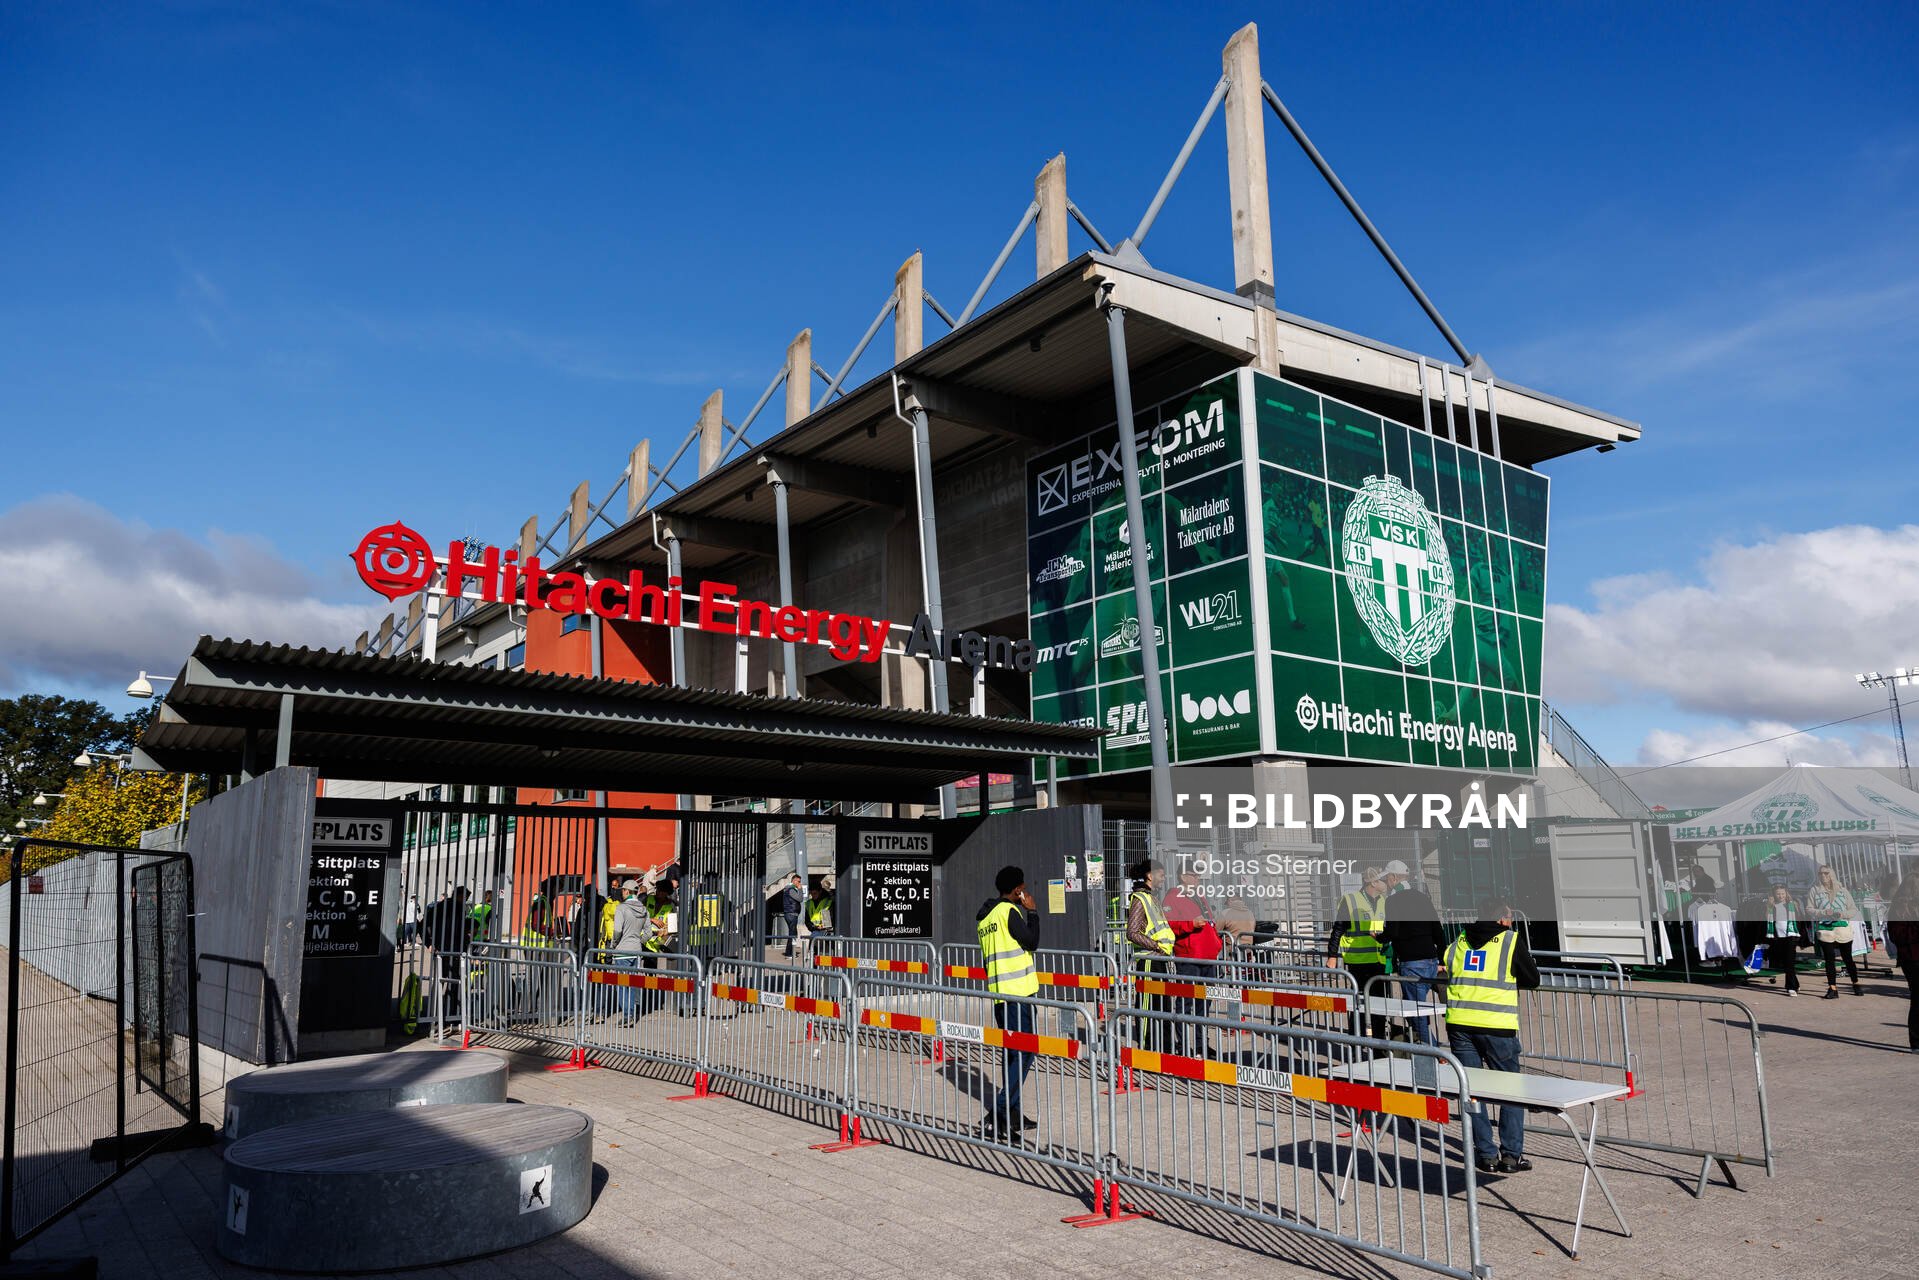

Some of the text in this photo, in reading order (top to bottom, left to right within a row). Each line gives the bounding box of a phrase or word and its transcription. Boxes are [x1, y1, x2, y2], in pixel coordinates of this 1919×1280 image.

[1072, 438, 1226, 503] EXPERTERNA FLYTT & MONTERING
[1179, 497, 1230, 527] Mälardalens
[1177, 515, 1235, 549] Takservice AB
[1379, 521, 1419, 546] VSK
[1354, 545, 1366, 562] 19
[1432, 564, 1444, 580] 04
[446, 540, 1039, 673] Hitachi Energy Arena
[1321, 701, 1518, 752] Hitachi Energy Arena
[1676, 818, 1877, 840] HELA STADENS KLUBB!
[864, 835, 929, 851] SITTPLATS
[317, 856, 380, 872] sittplats
[866, 861, 929, 874] Entré sittplats
[309, 875, 350, 888] ektion
[884, 876, 912, 885] Sektion
[368, 890, 379, 905] E
[866, 887, 878, 901] A,
[923, 887, 930, 899] E
[884, 902, 912, 911] Sektion
[304, 909, 346, 921] ektion
[893, 913, 903, 925] M
[312, 924, 330, 939] M
[302, 941, 359, 955] iljeläktare)
[946, 1023, 981, 1040] ROCKLUNDA
[1236, 1065, 1292, 1090] ROCKLUNDA
